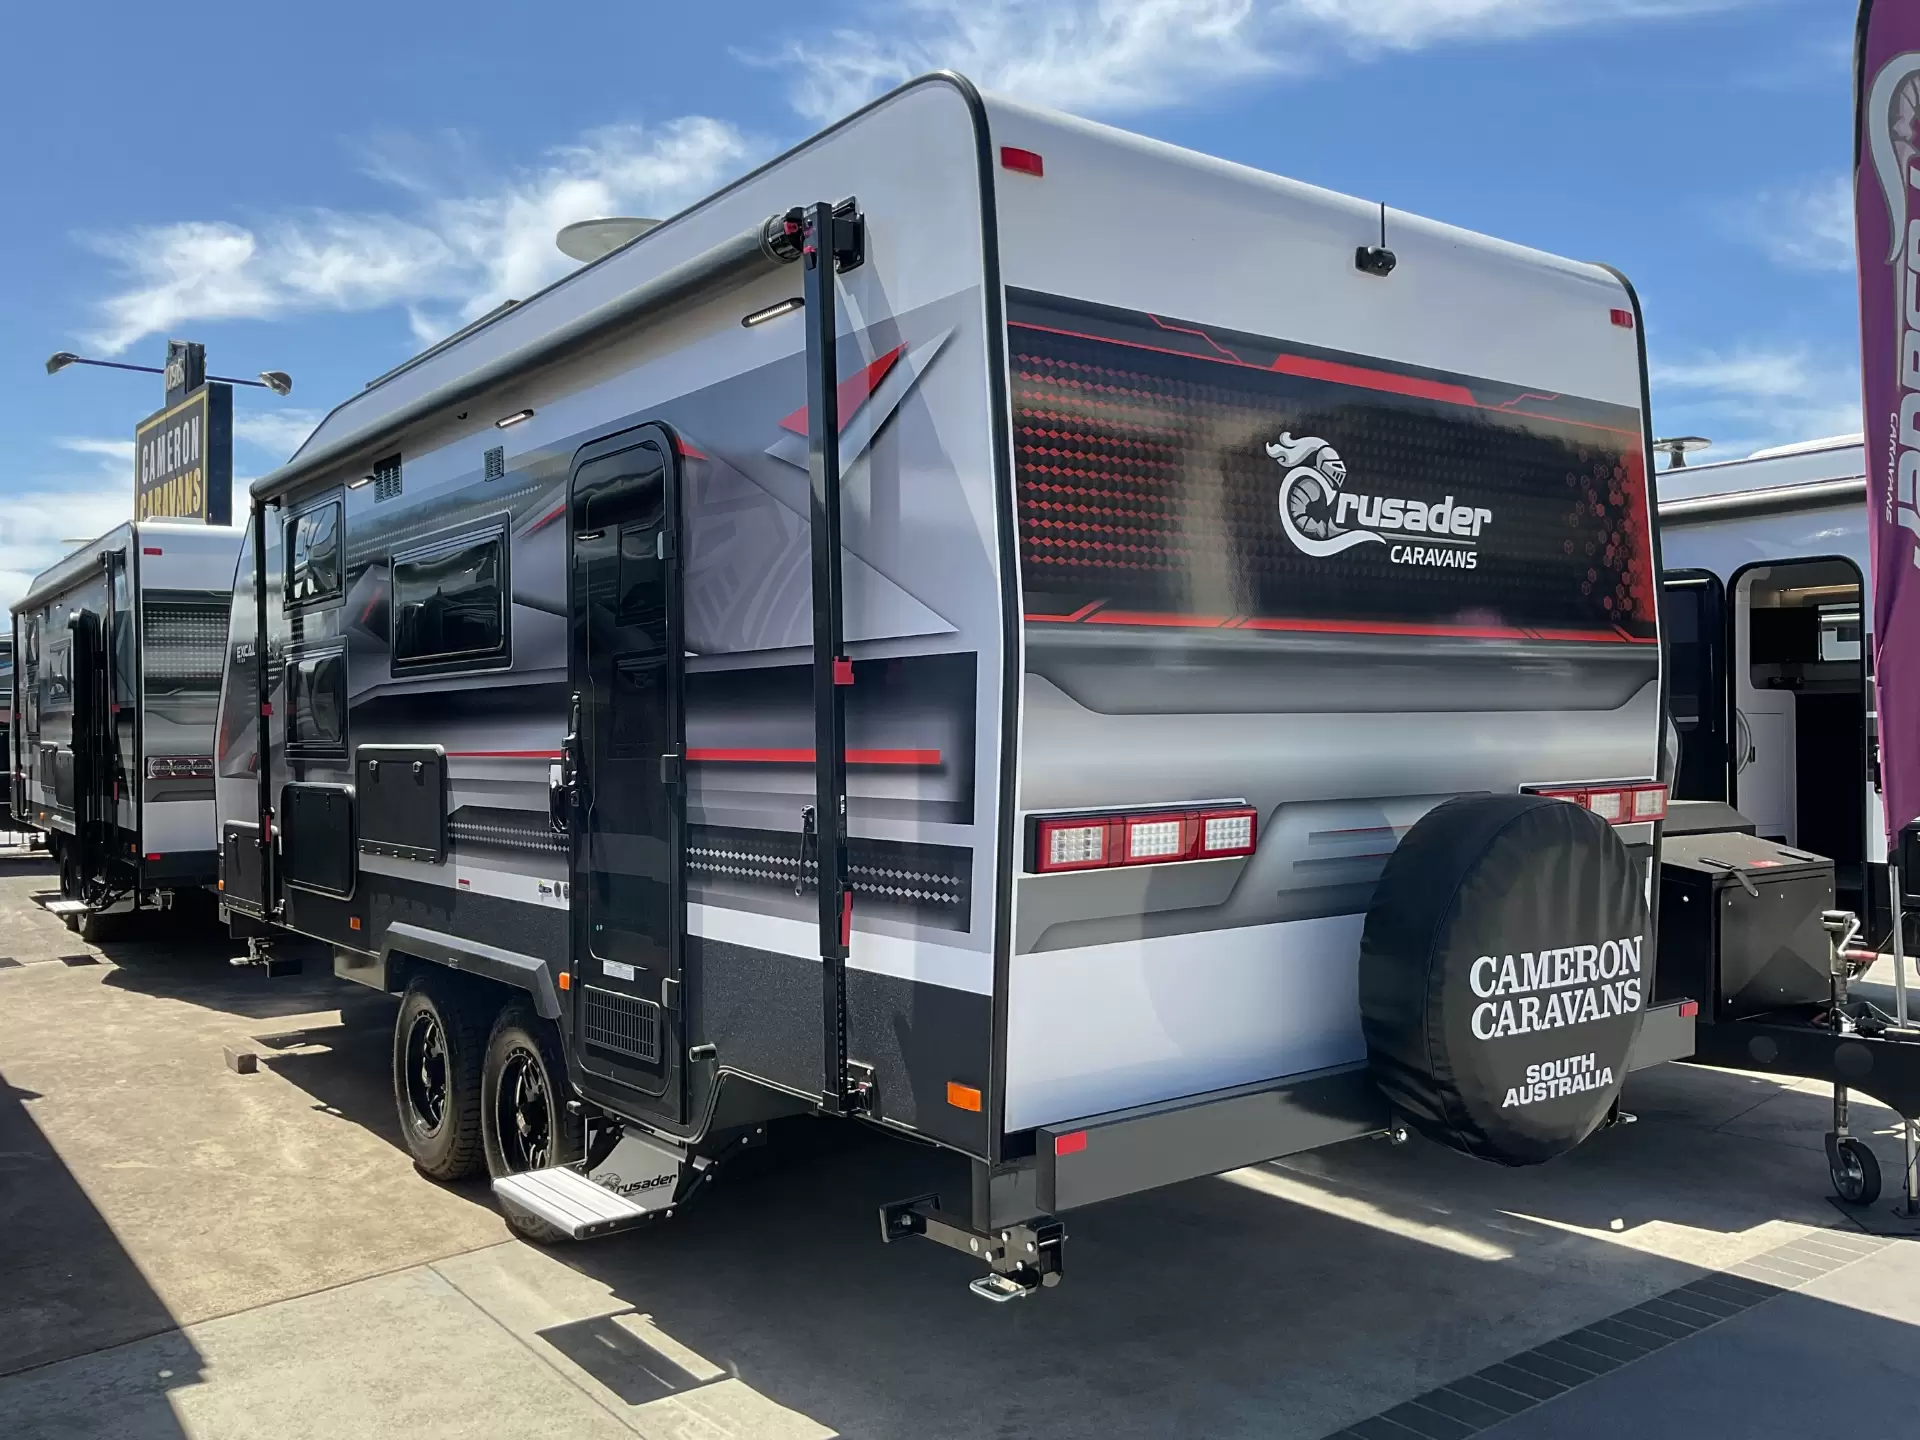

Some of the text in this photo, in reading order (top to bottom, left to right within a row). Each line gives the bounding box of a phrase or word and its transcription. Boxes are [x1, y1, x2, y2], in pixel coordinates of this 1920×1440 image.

[142, 415, 200, 485] CAMERON
[1886, 412, 1899, 524] CARAVANS
[139, 467, 202, 521] CARAVANS
[1278, 466, 1492, 557] Crusader
[1390, 545, 1478, 569] CARAVANS
[1469, 935, 1644, 998] CAMERON
[1471, 977, 1642, 1041] CARAVANS
[1502, 1066, 1614, 1108] AUSTRALIA
[1526, 1052, 1596, 1084] SOUTH
[604, 1173, 678, 1198] rusader
